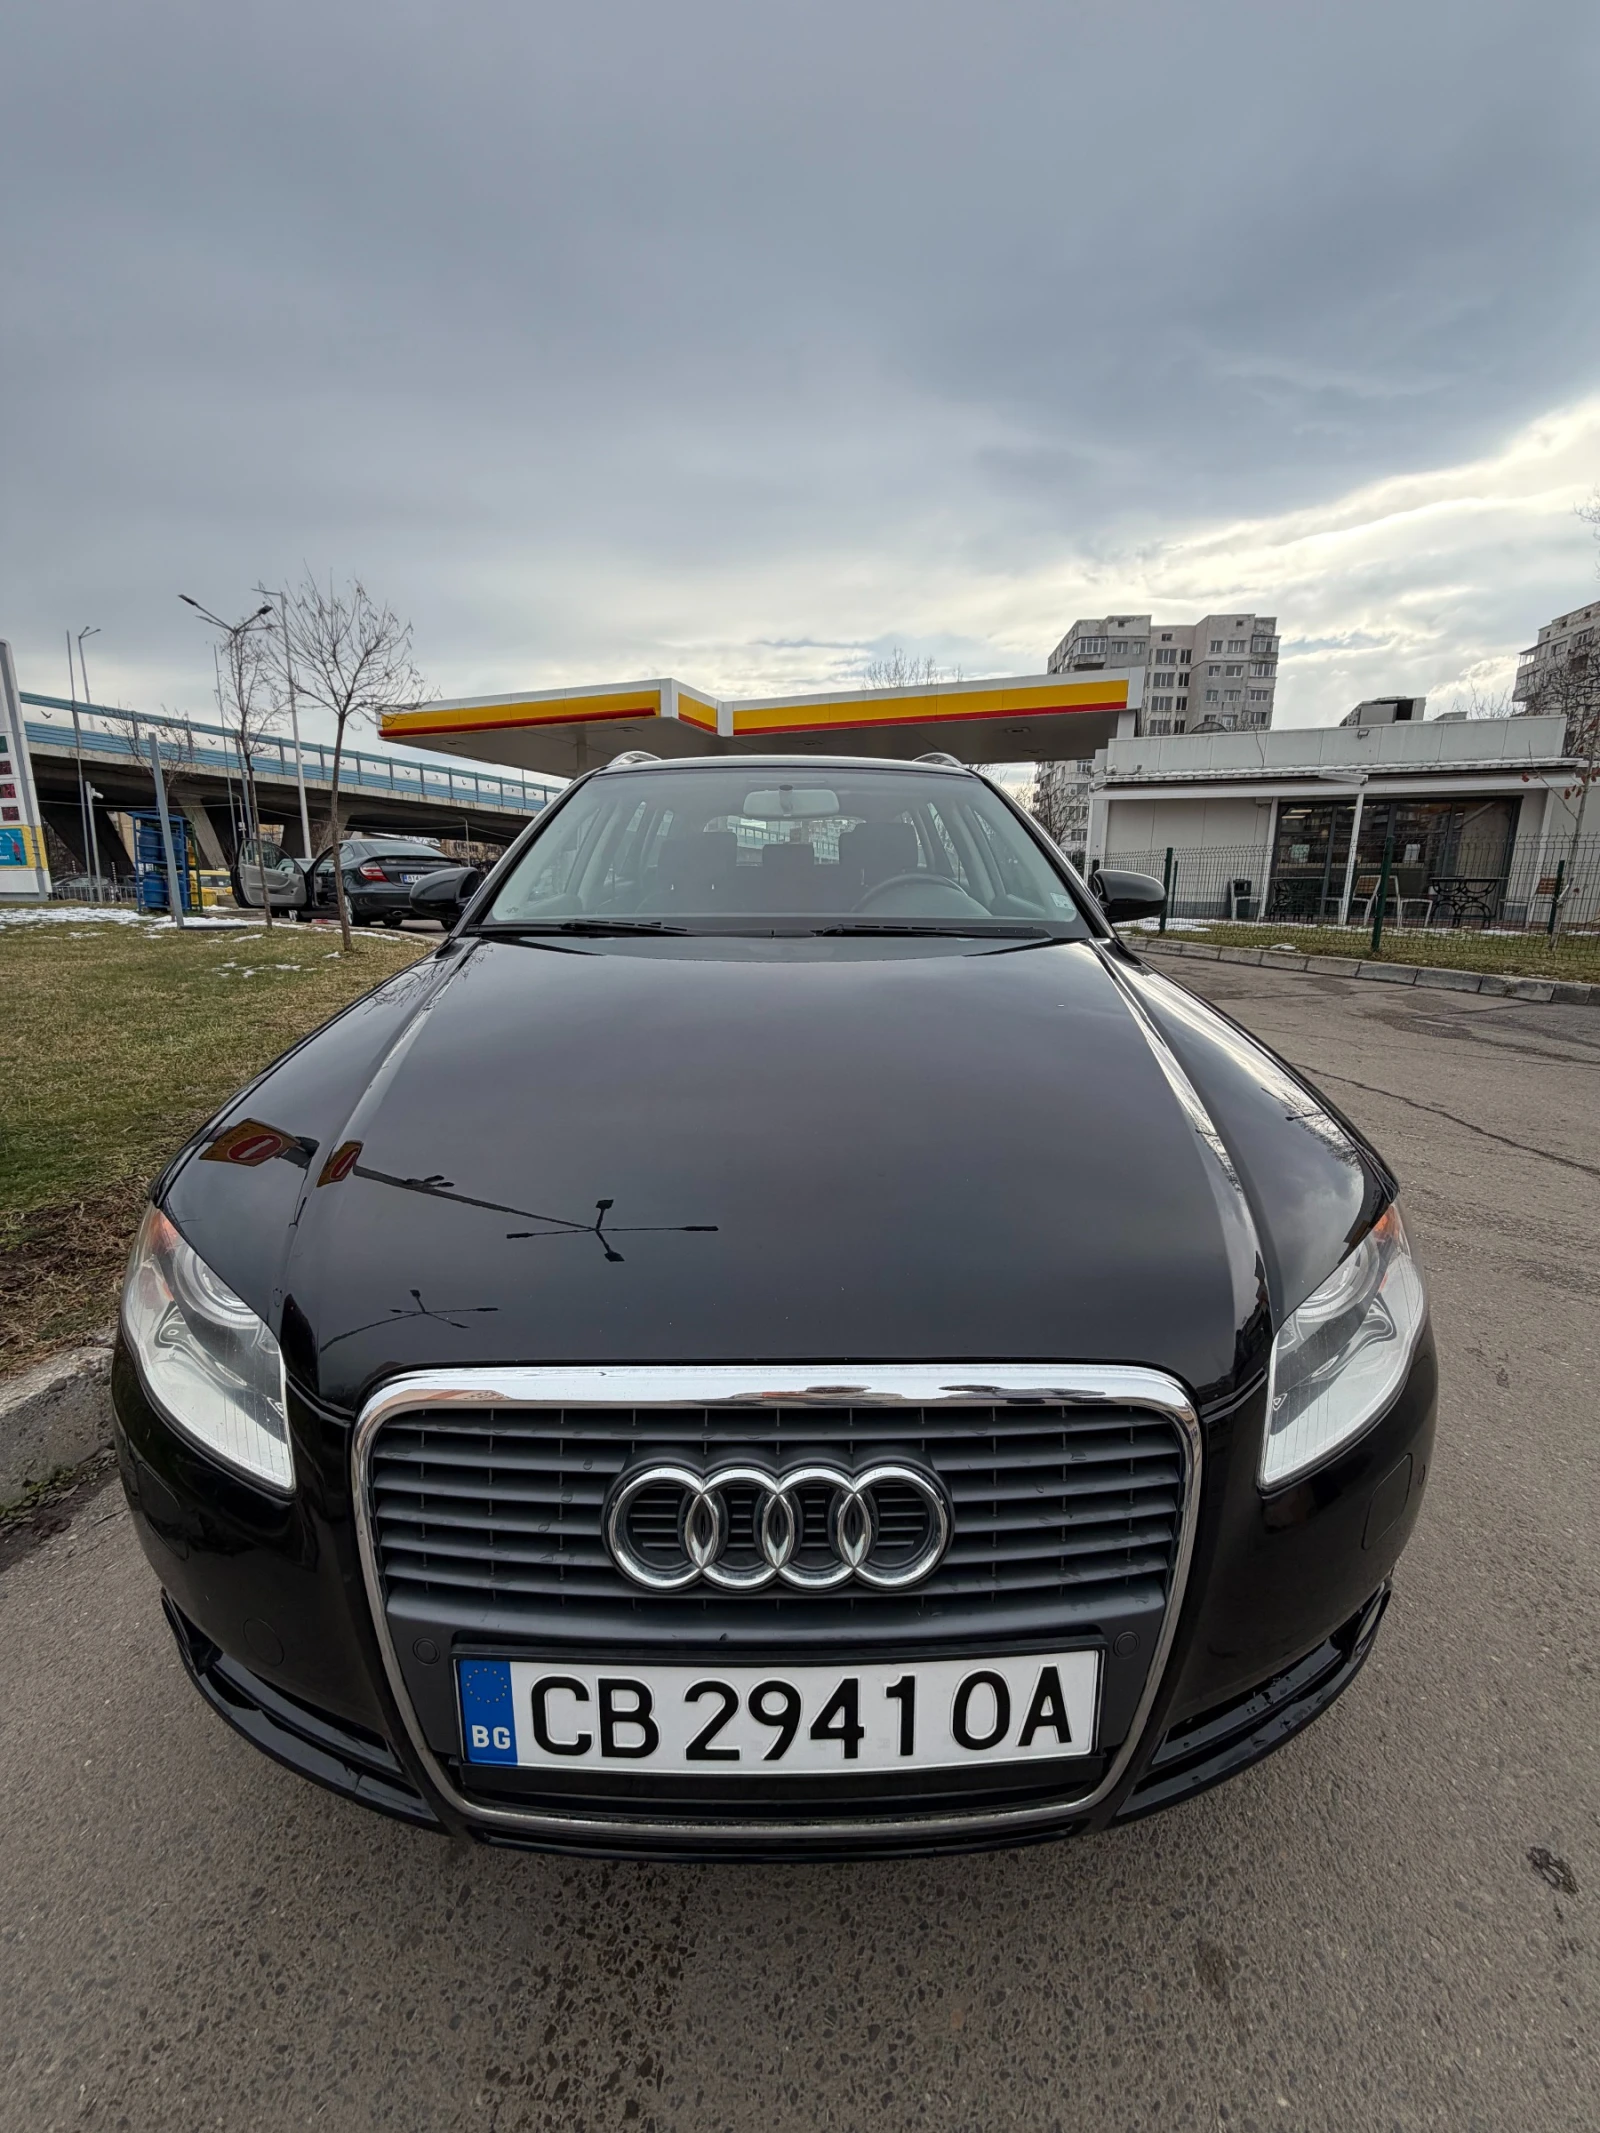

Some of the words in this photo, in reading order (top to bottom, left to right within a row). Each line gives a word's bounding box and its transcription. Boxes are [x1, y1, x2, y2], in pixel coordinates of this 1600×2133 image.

[471, 1724, 511, 1750] BG
[531, 1676, 660, 1758] CB
[684, 1674, 916, 1761] 2941
[949, 1665, 1072, 1751] OA
